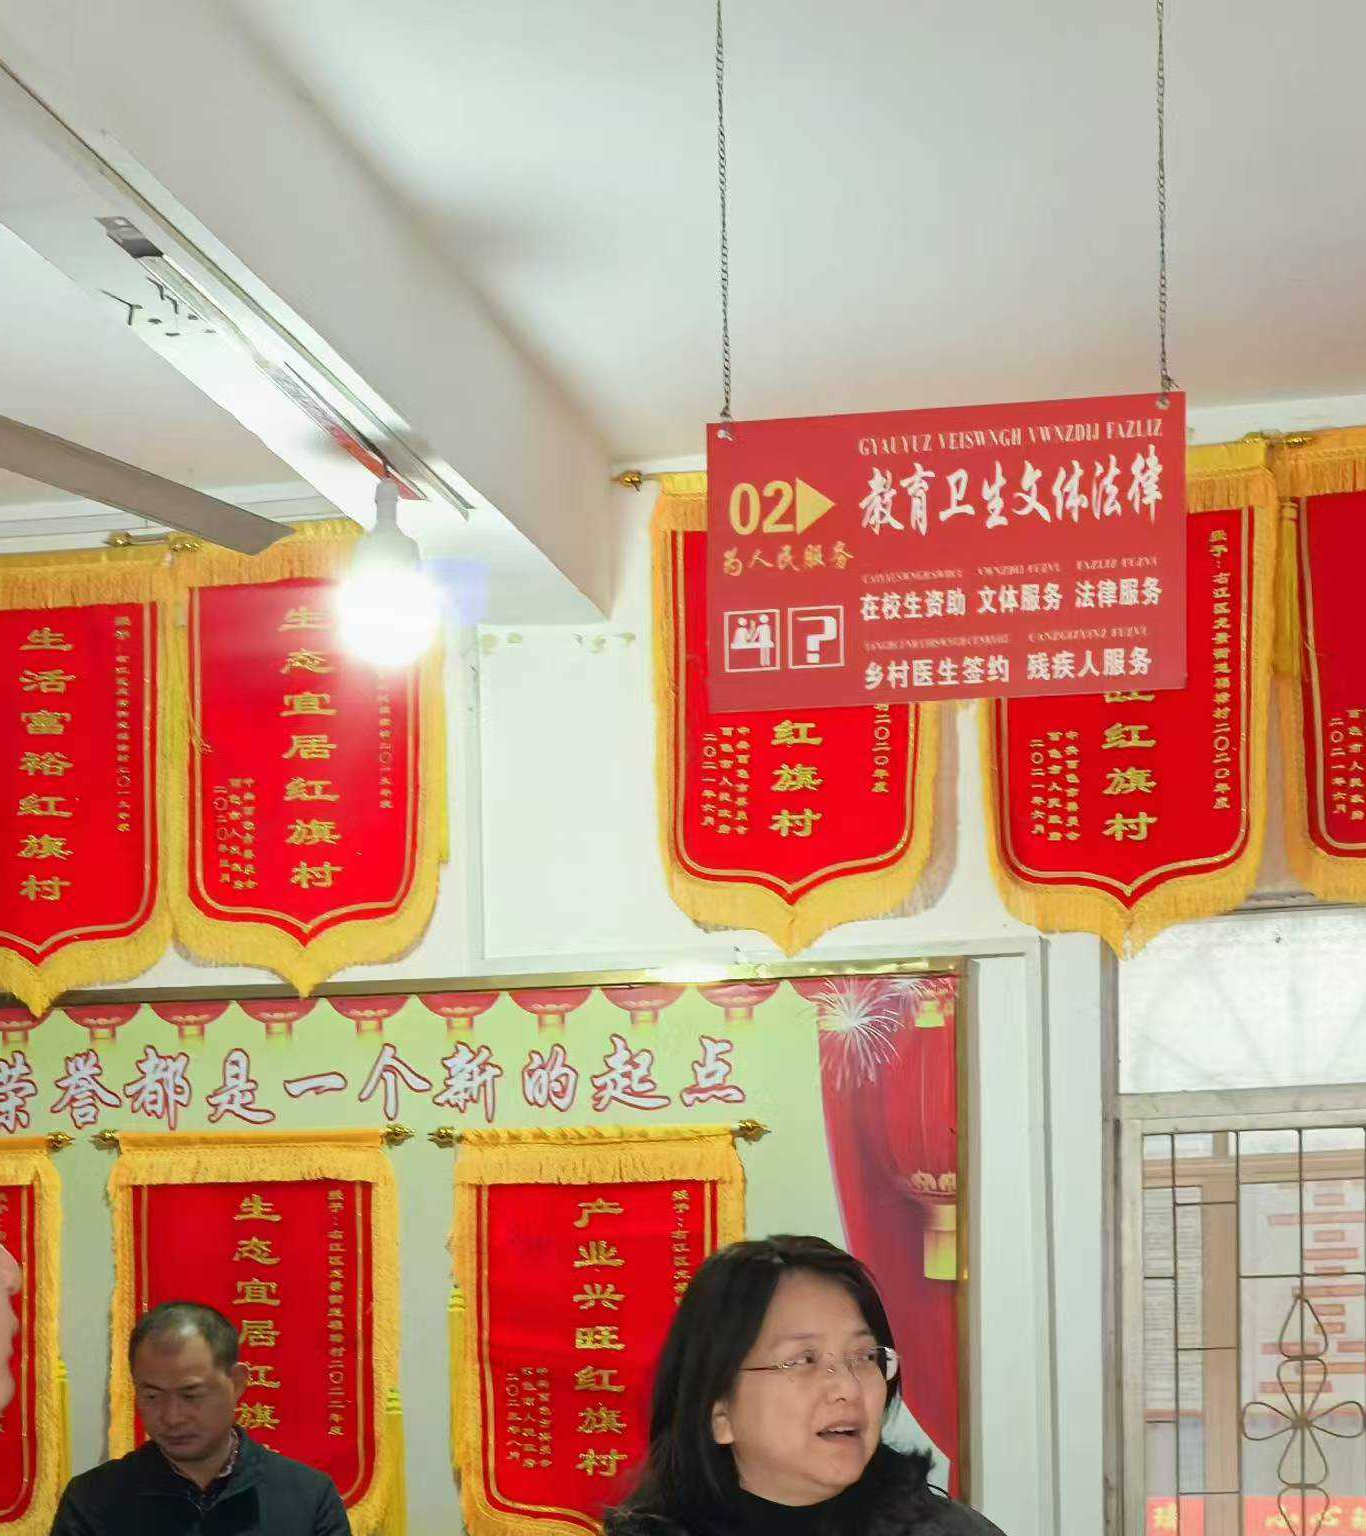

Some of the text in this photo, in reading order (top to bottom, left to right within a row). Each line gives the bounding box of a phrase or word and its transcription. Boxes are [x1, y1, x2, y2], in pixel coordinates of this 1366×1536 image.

[729, 480, 795, 535] 02
[857, 444, 1165, 537] 教育卫生文体法律
[723, 540, 854, 577] 为人民服务
[860, 576, 1162, 622] 在校生资助 文体服务 法律服务
[865, 646, 1152, 690] 乡村医生签约 残疾人服务
[16, 626, 77, 901] 生活富裕红旗村
[276, 606, 341, 890] 生态宜居红旗村
[768, 719, 824, 838] 红旗村
[231, 1192, 285, 1454] 生态宜居红旗
[572, 1197, 628, 1477] 产业兴旺红旗村
